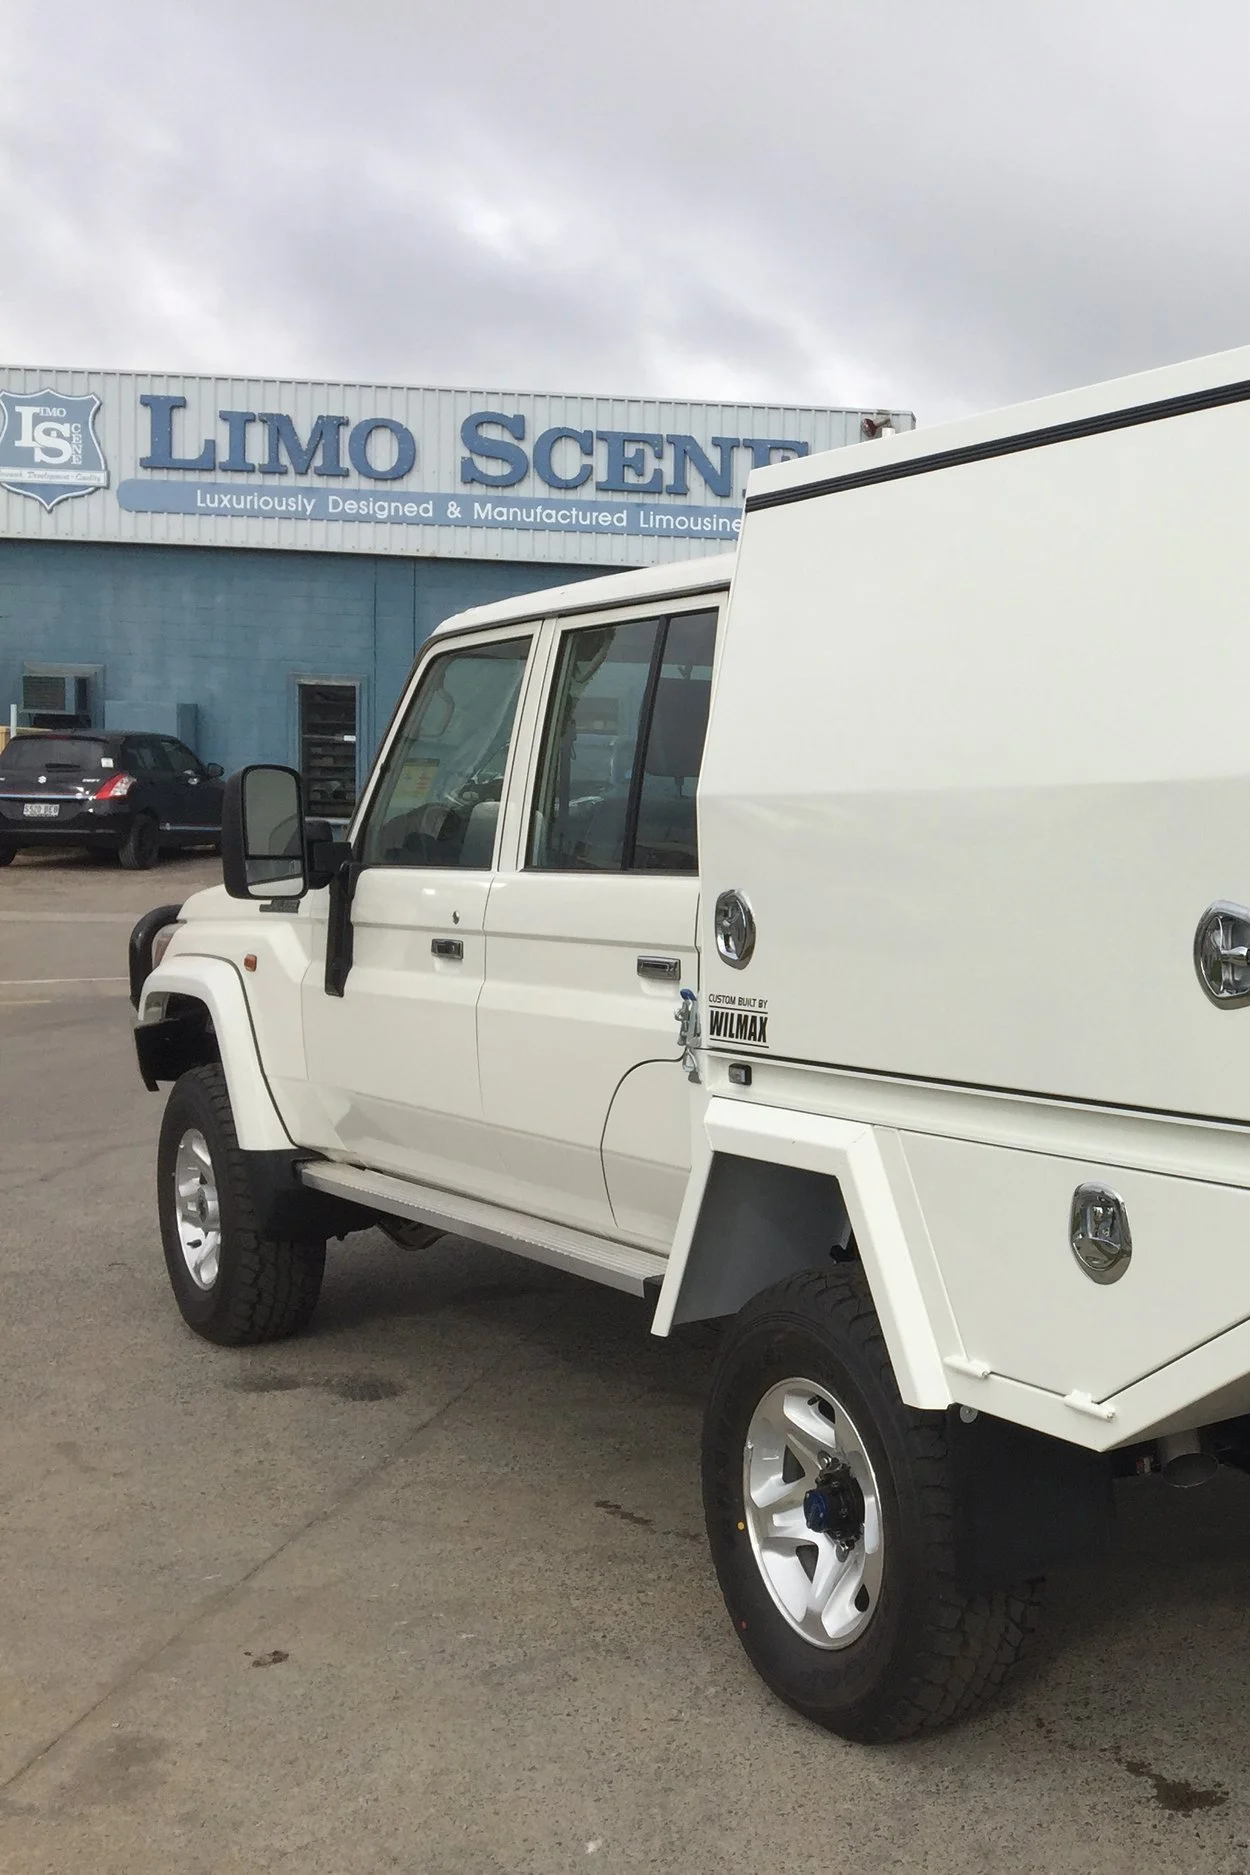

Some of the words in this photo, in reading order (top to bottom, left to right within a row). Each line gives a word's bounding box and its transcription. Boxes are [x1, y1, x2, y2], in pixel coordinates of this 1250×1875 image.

[140, 394, 417, 481] LIMO
[197, 489, 316, 515] Luxuriously
[328, 495, 433, 519] Designed
[447, 501, 462, 519] &
[473, 503, 628, 527] Manufactured
[709, 993, 736, 1005] CUSTOM
[737, 997, 757, 1008] BUILT
[758, 999, 768, 1009] BY
[709, 1010, 768, 1043] WILMAX
